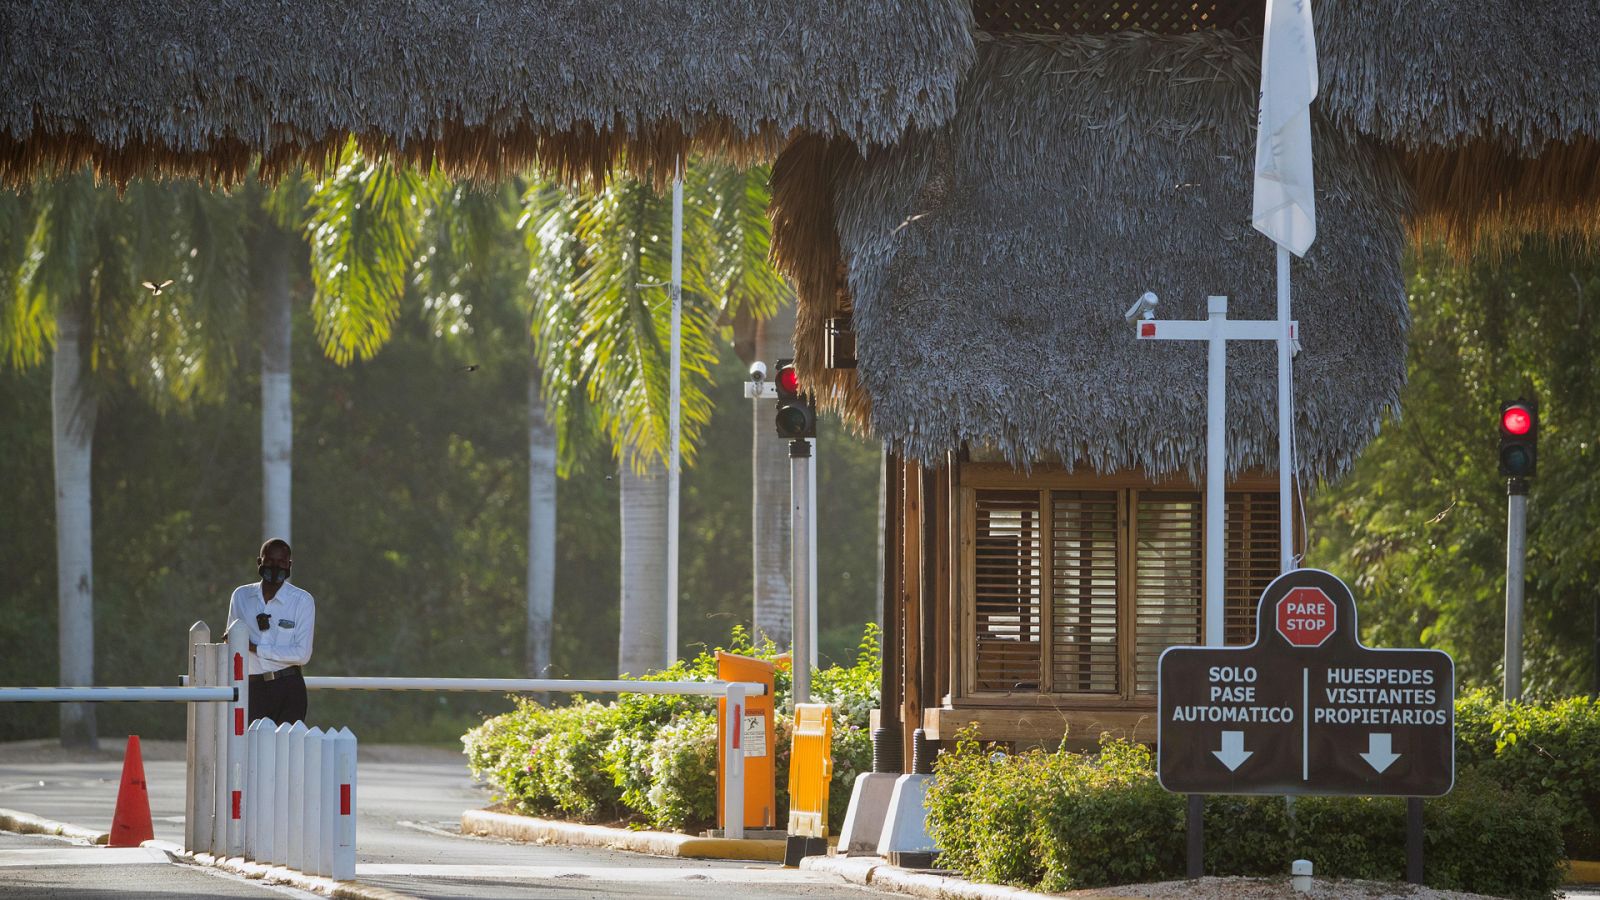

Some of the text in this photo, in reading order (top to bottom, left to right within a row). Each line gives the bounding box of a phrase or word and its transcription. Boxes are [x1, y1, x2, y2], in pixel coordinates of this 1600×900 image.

[1286, 603, 1326, 615] PARE
[1286, 618, 1326, 631] STOP
[1209, 667, 1258, 682] SOLO
[1327, 668, 1434, 684] HUESPEDES
[1210, 687, 1256, 702] PASE
[1326, 688, 1436, 705] VISITANTES
[1172, 706, 1294, 723] AUTOMATICO
[1314, 708, 1447, 725] PROPIETARIOS
